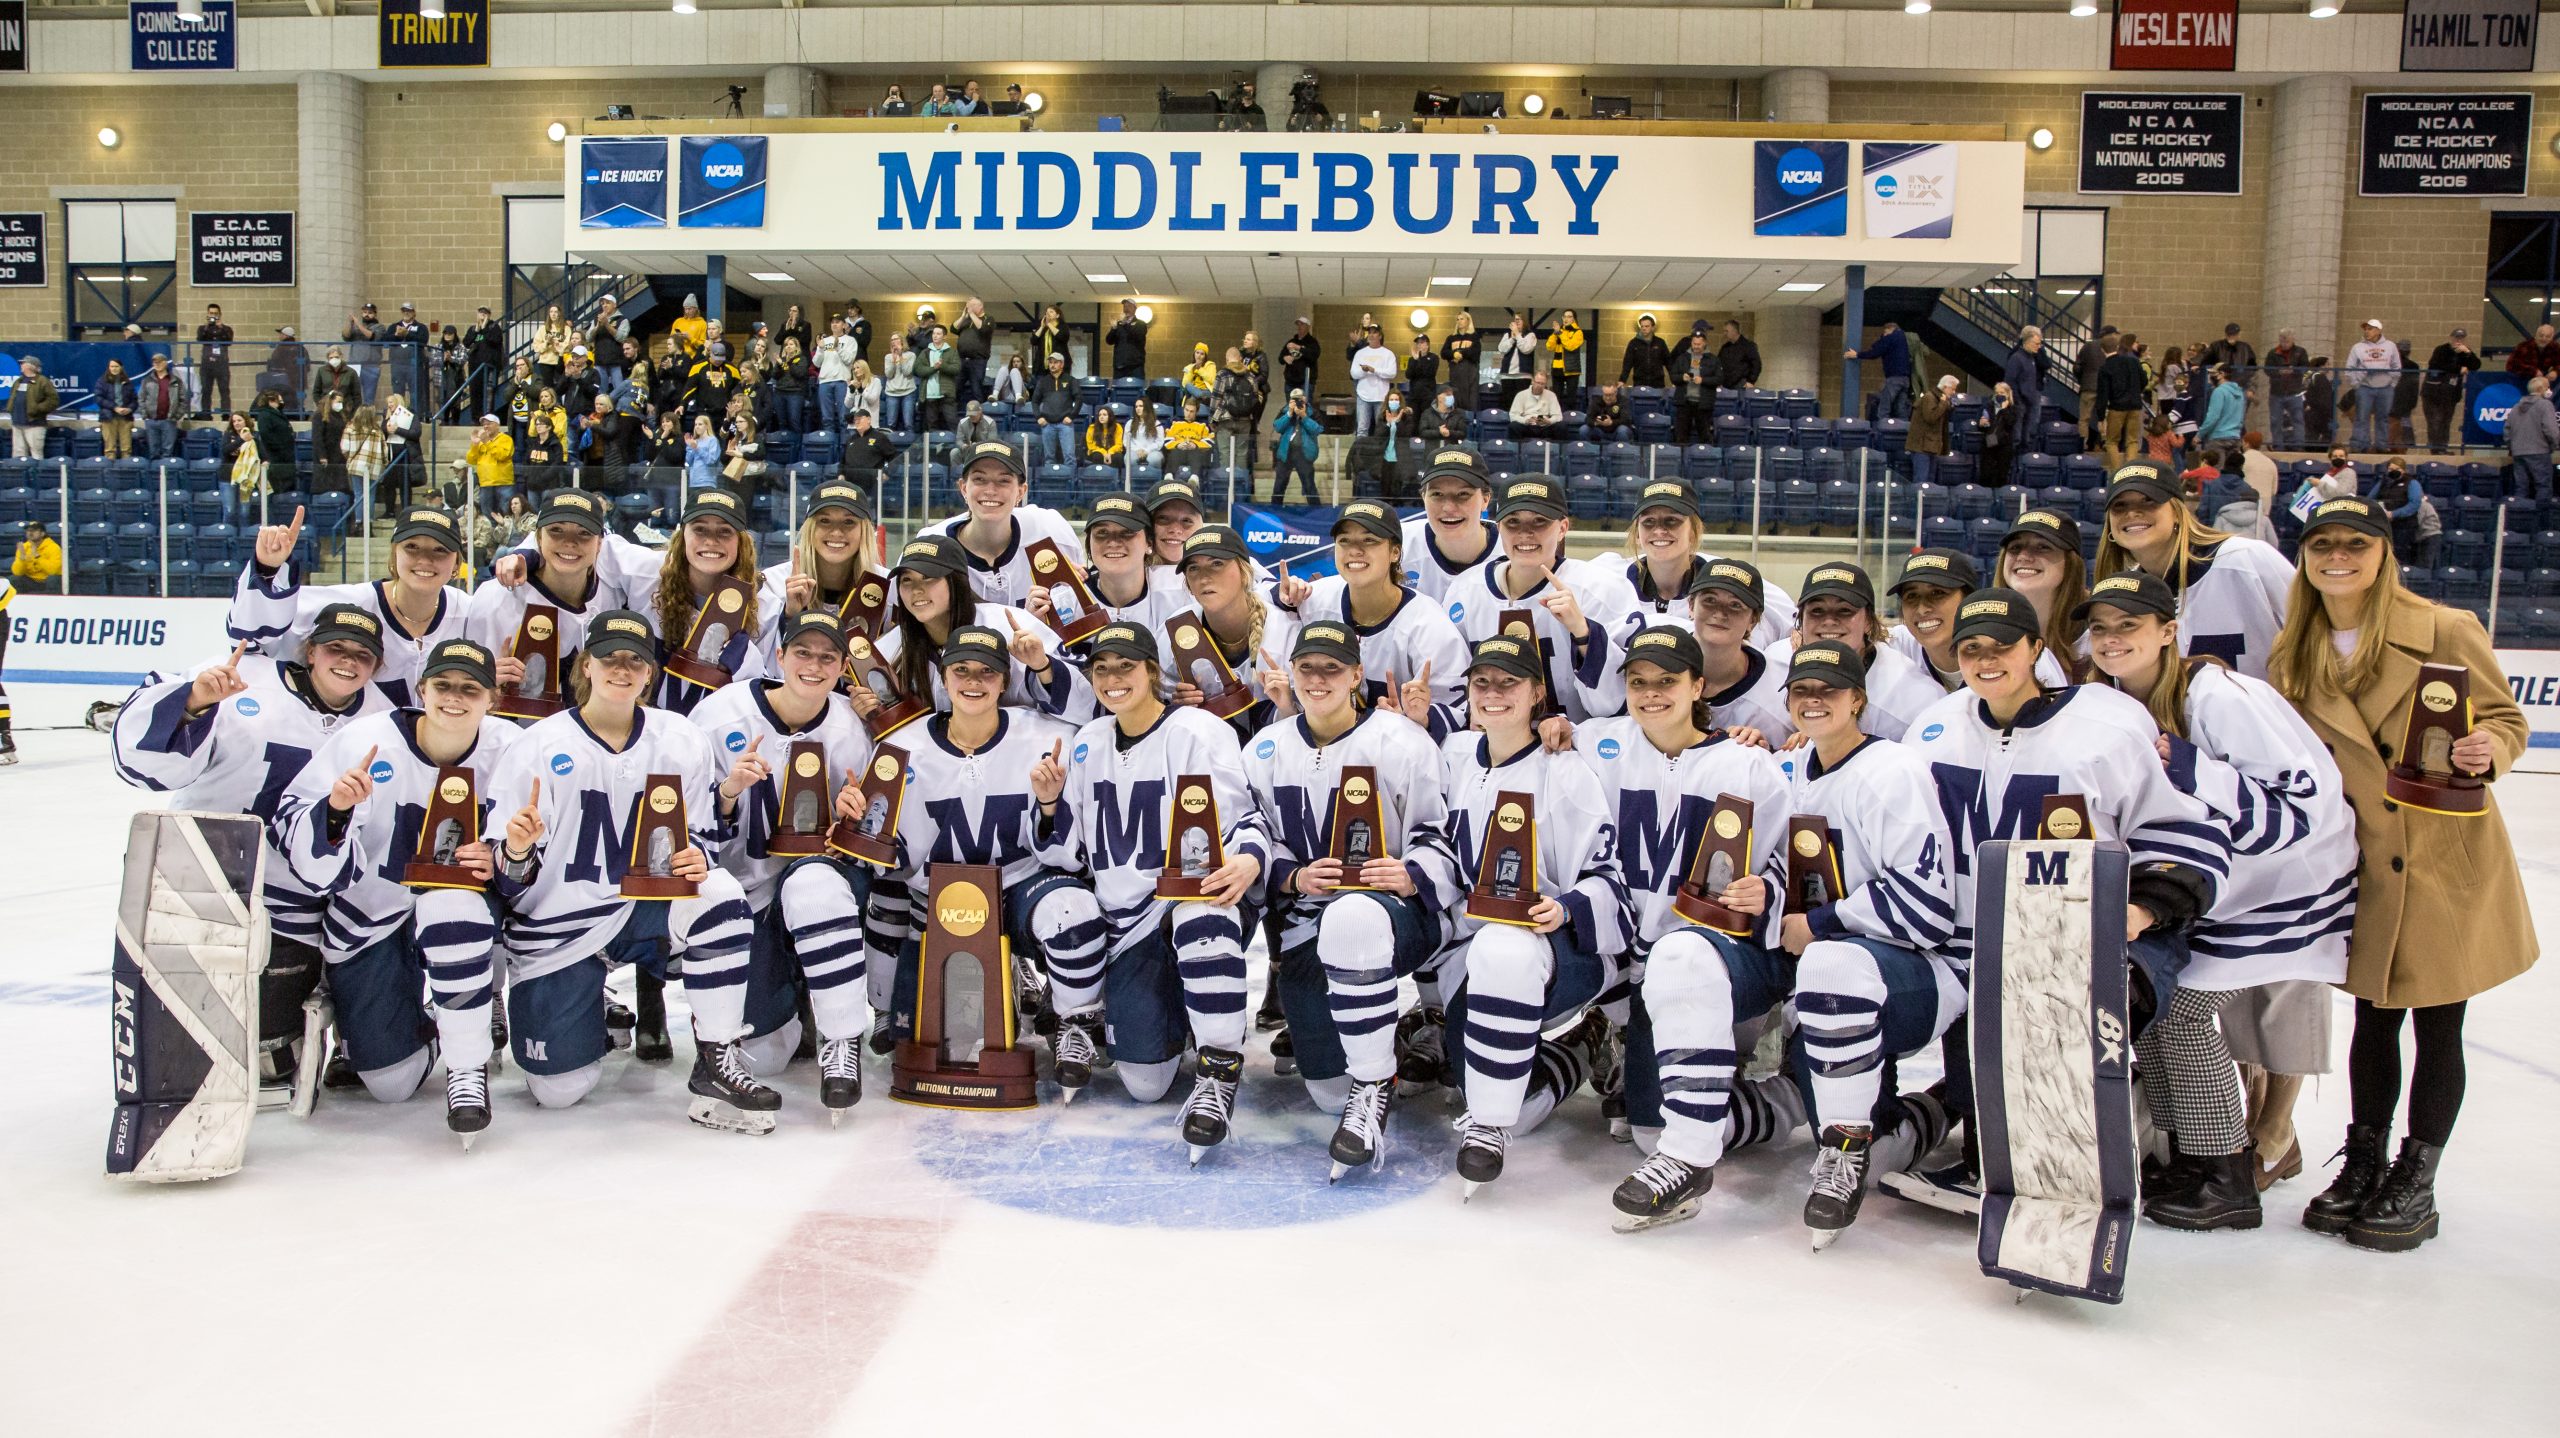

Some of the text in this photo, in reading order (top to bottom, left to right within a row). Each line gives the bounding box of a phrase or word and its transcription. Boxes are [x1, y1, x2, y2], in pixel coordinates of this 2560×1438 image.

[389, 12, 477, 45] TRINITY
[2119, 12, 2232, 48] WESLEYAN
[2410, 14, 2530, 49] HAMILTON
[147, 40, 217, 61] COLLEGE
[2098, 101, 2227, 111] MIDDLEBURY COLLEGE
[2381, 102, 2515, 111] MIDDLEBURY COLLEGE
[2110, 133, 2213, 146] ICE HOCKEY
[2395, 135, 2496, 148] ICE HOCKEY
[2096, 152, 2226, 168] NATIONAL CHAMPIONS
[2378, 154, 2511, 169] NATIONAL CHAMPIONS
[601, 170, 618, 182] ICE
[620, 170, 663, 182] HOCKEY
[705, 165, 743, 178] NCAA
[1781, 171, 1823, 184] NCAA
[2136, 173, 2184, 185] 2005
[2420, 175, 2467, 188] 2006
[878, 151, 1619, 235] MIDDLEBURY
[5, 237, 36, 247] HOCKEY
[201, 235, 282, 246] WOMEN'S ICE HOCKEY
[202, 252, 282, 263] CHAMPIONS
[224, 267, 260, 278] 2001
[1247, 531, 1320, 545] NCAA.com
[36, 618, 166, 645] ADOLPHUS
[2423, 694, 2456, 707] NCAA
[1346, 789, 1369, 797] NCAA
[1183, 798, 1208, 806] NCAA
[1092, 777, 1166, 871] M
[1931, 762, 2060, 876] M
[924, 794, 1033, 877] M
[1619, 788, 1715, 896] M
[2025, 851, 2069, 885] M
[940, 907, 987, 925] NCAA
[114, 980, 137, 1095] CCM
[525, 1038, 548, 1061] M
[916, 1082, 997, 1098] NATIONAL CHAMPION
